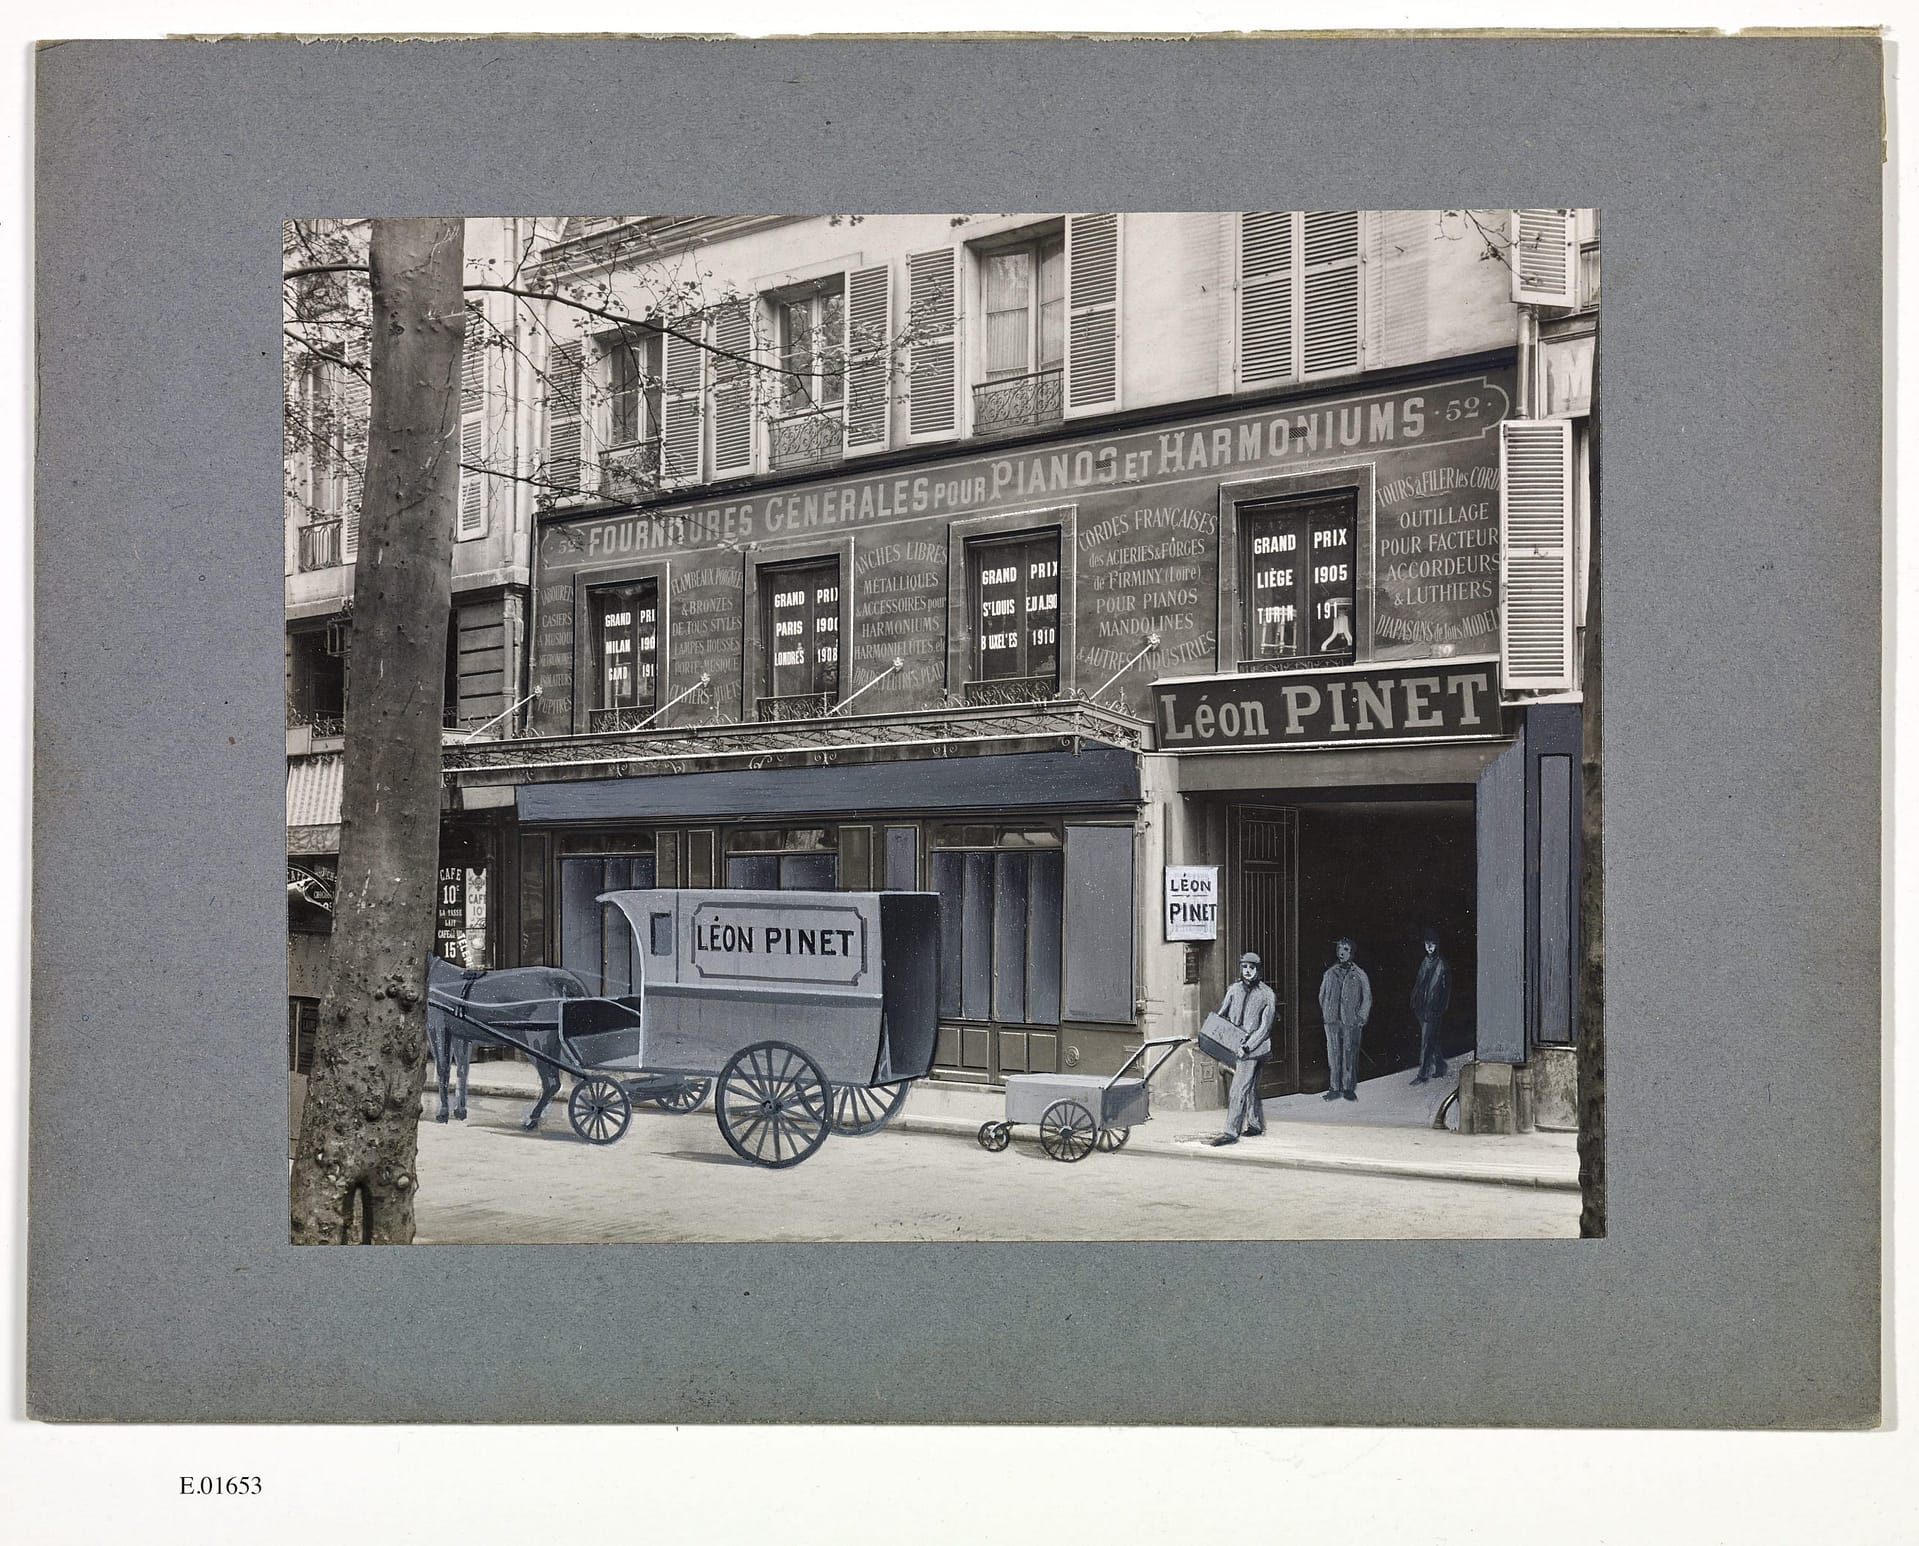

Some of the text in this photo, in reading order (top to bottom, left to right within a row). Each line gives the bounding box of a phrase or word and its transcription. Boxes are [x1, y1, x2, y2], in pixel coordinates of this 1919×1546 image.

[588, 504, 754, 556] FOURNITURES
[765, 476, 930, 532] GÉNÉRALES
[934, 475, 987, 508] POUR
[1125, 450, 1153, 481] ET
[1158, 396, 1425, 474] HARMONIUMS
[1445, 396, 1481, 422] 52
[1422, 467, 1454, 493] FILER
[1470, 466, 1500, 491] CORD
[1400, 503, 1489, 529] OUTILLAGE
[1079, 507, 1217, 552] CORDES FRANÇAISES
[1254, 528, 1347, 555] GRAND PRIX
[1381, 526, 1499, 557] POUR FACTEUR
[906, 541, 947, 565] LIBRES
[982, 561, 1058, 585] GRAND PRIX
[1108, 567, 1163, 590] FIRMINY
[1314, 564, 1348, 584] 1905
[1387, 552, 1499, 581] ACCORDEURS
[774, 590, 805, 608] GRAND
[1096, 588, 1198, 614] POUR PIANOS
[1406, 580, 1493, 605] LUTHIERS
[604, 608, 656, 628] GRAND PRI
[1257, 601, 1338, 625] TURIN 191
[775, 620, 804, 637] PARIS
[861, 616, 941, 638] HARMONIUMS
[1032, 627, 1055, 646] 1910
[1099, 613, 1194, 638] MANDOLINES
[604, 636, 656, 654] MILAN 190
[774, 646, 838, 667] LONDRES 1908
[608, 663, 656, 681] GAND 191
[1160, 673, 1488, 740] Léon PINET
[1170, 873, 1212, 893] LÉON
[1169, 902, 1218, 925] PINET
[697, 915, 855, 957] LÉON PINET
